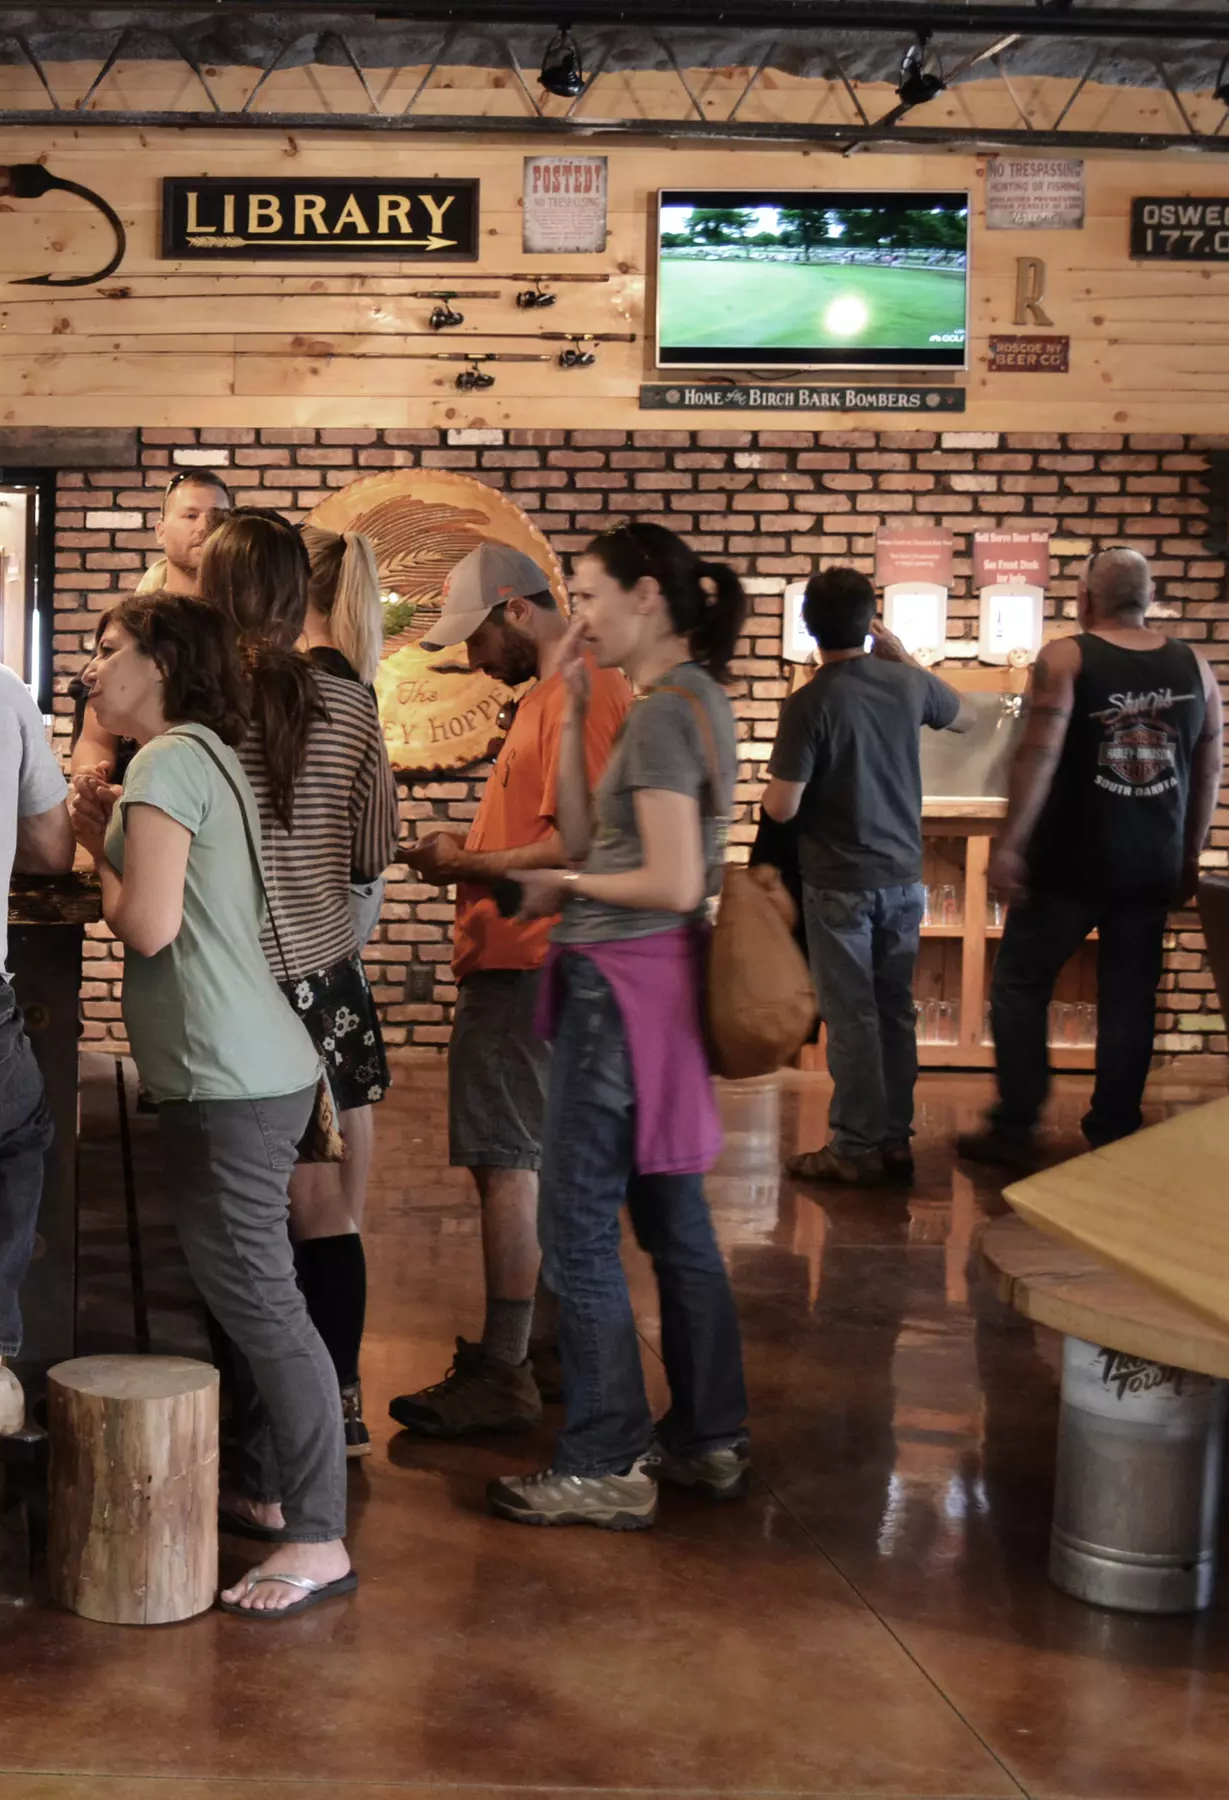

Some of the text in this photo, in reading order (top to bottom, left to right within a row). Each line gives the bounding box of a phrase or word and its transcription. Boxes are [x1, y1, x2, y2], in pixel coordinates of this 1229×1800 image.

[532, 164, 602, 194] POSTED!
[185, 191, 456, 235] LIBRARY
[1012, 256, 1055, 328] R
[995, 342, 1044, 354] ROSCOE
[995, 353, 1038, 366] BEER
[684, 388, 724, 406] HOME
[749, 389, 795, 407] BIRCH
[798, 390, 841, 408] BARK
[845, 390, 921, 409] BOMBERS
